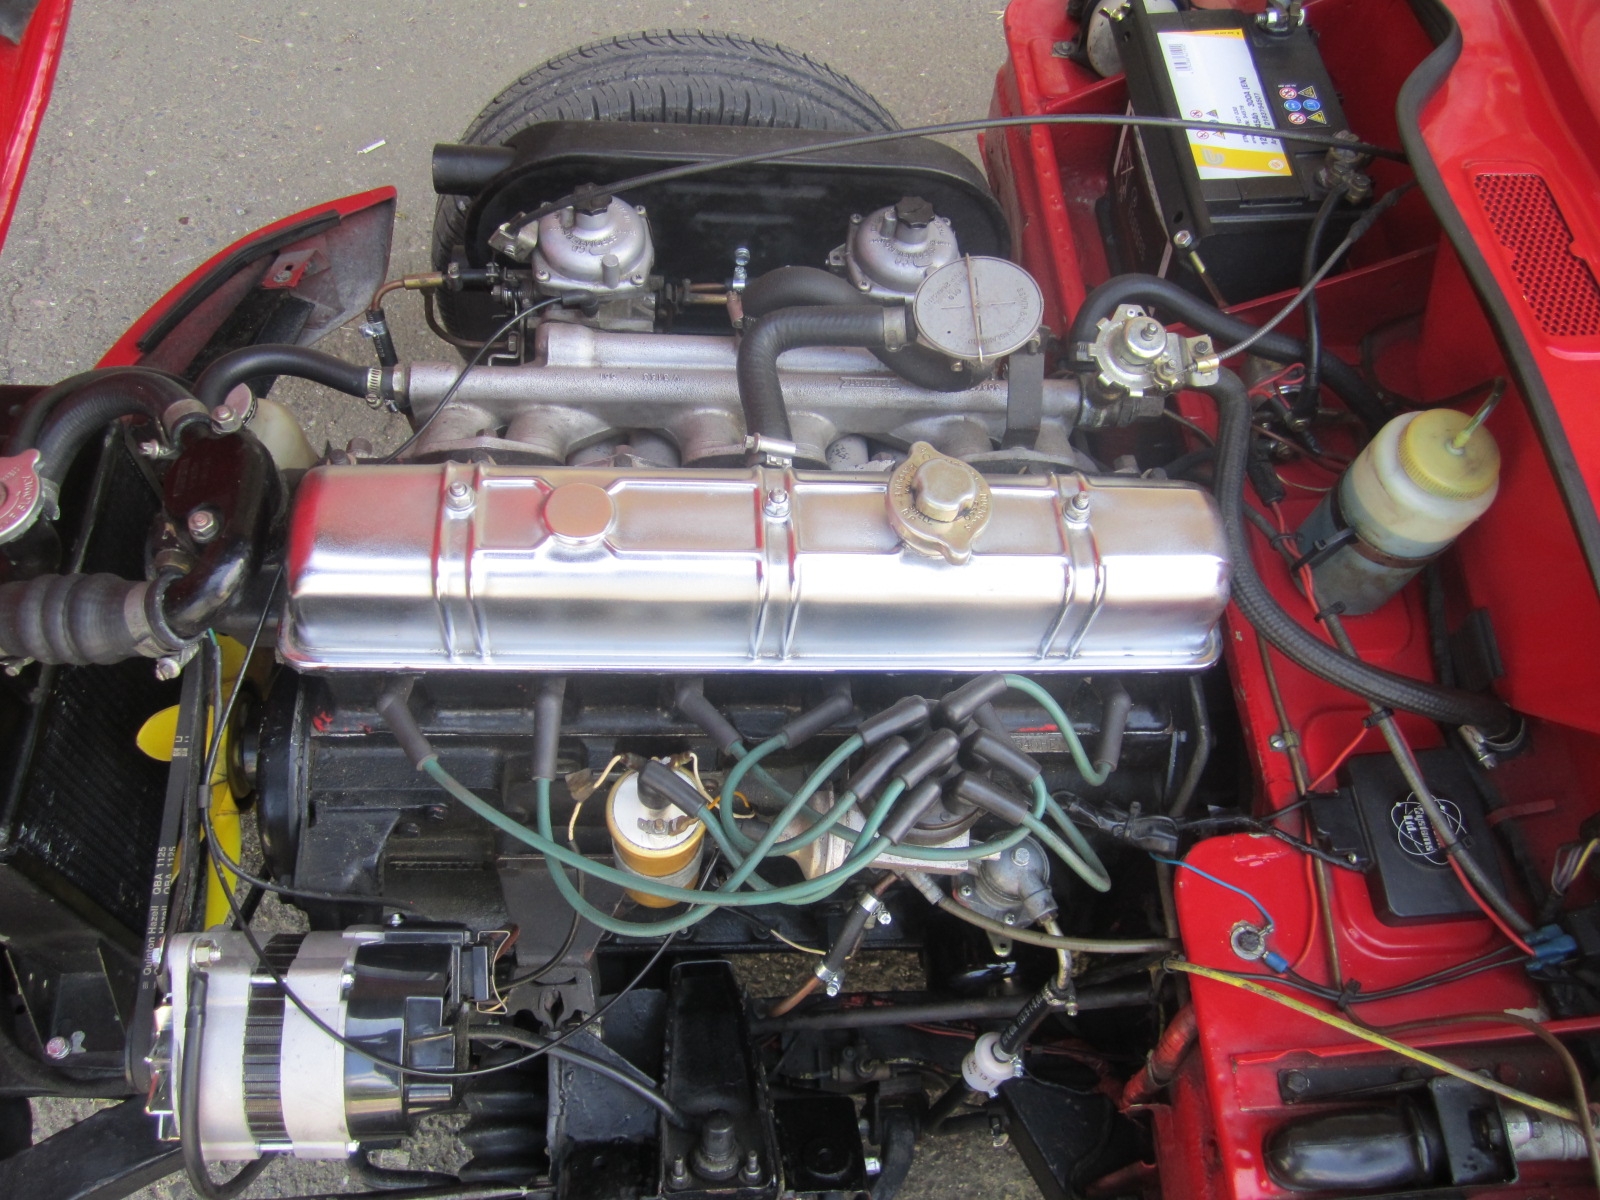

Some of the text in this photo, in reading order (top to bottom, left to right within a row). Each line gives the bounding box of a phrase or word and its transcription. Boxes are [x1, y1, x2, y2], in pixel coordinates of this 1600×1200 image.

[1239, 77, 1250, 90] (EN)
[143, 846, 168, 976] Quinton Hazell QBA 1125
